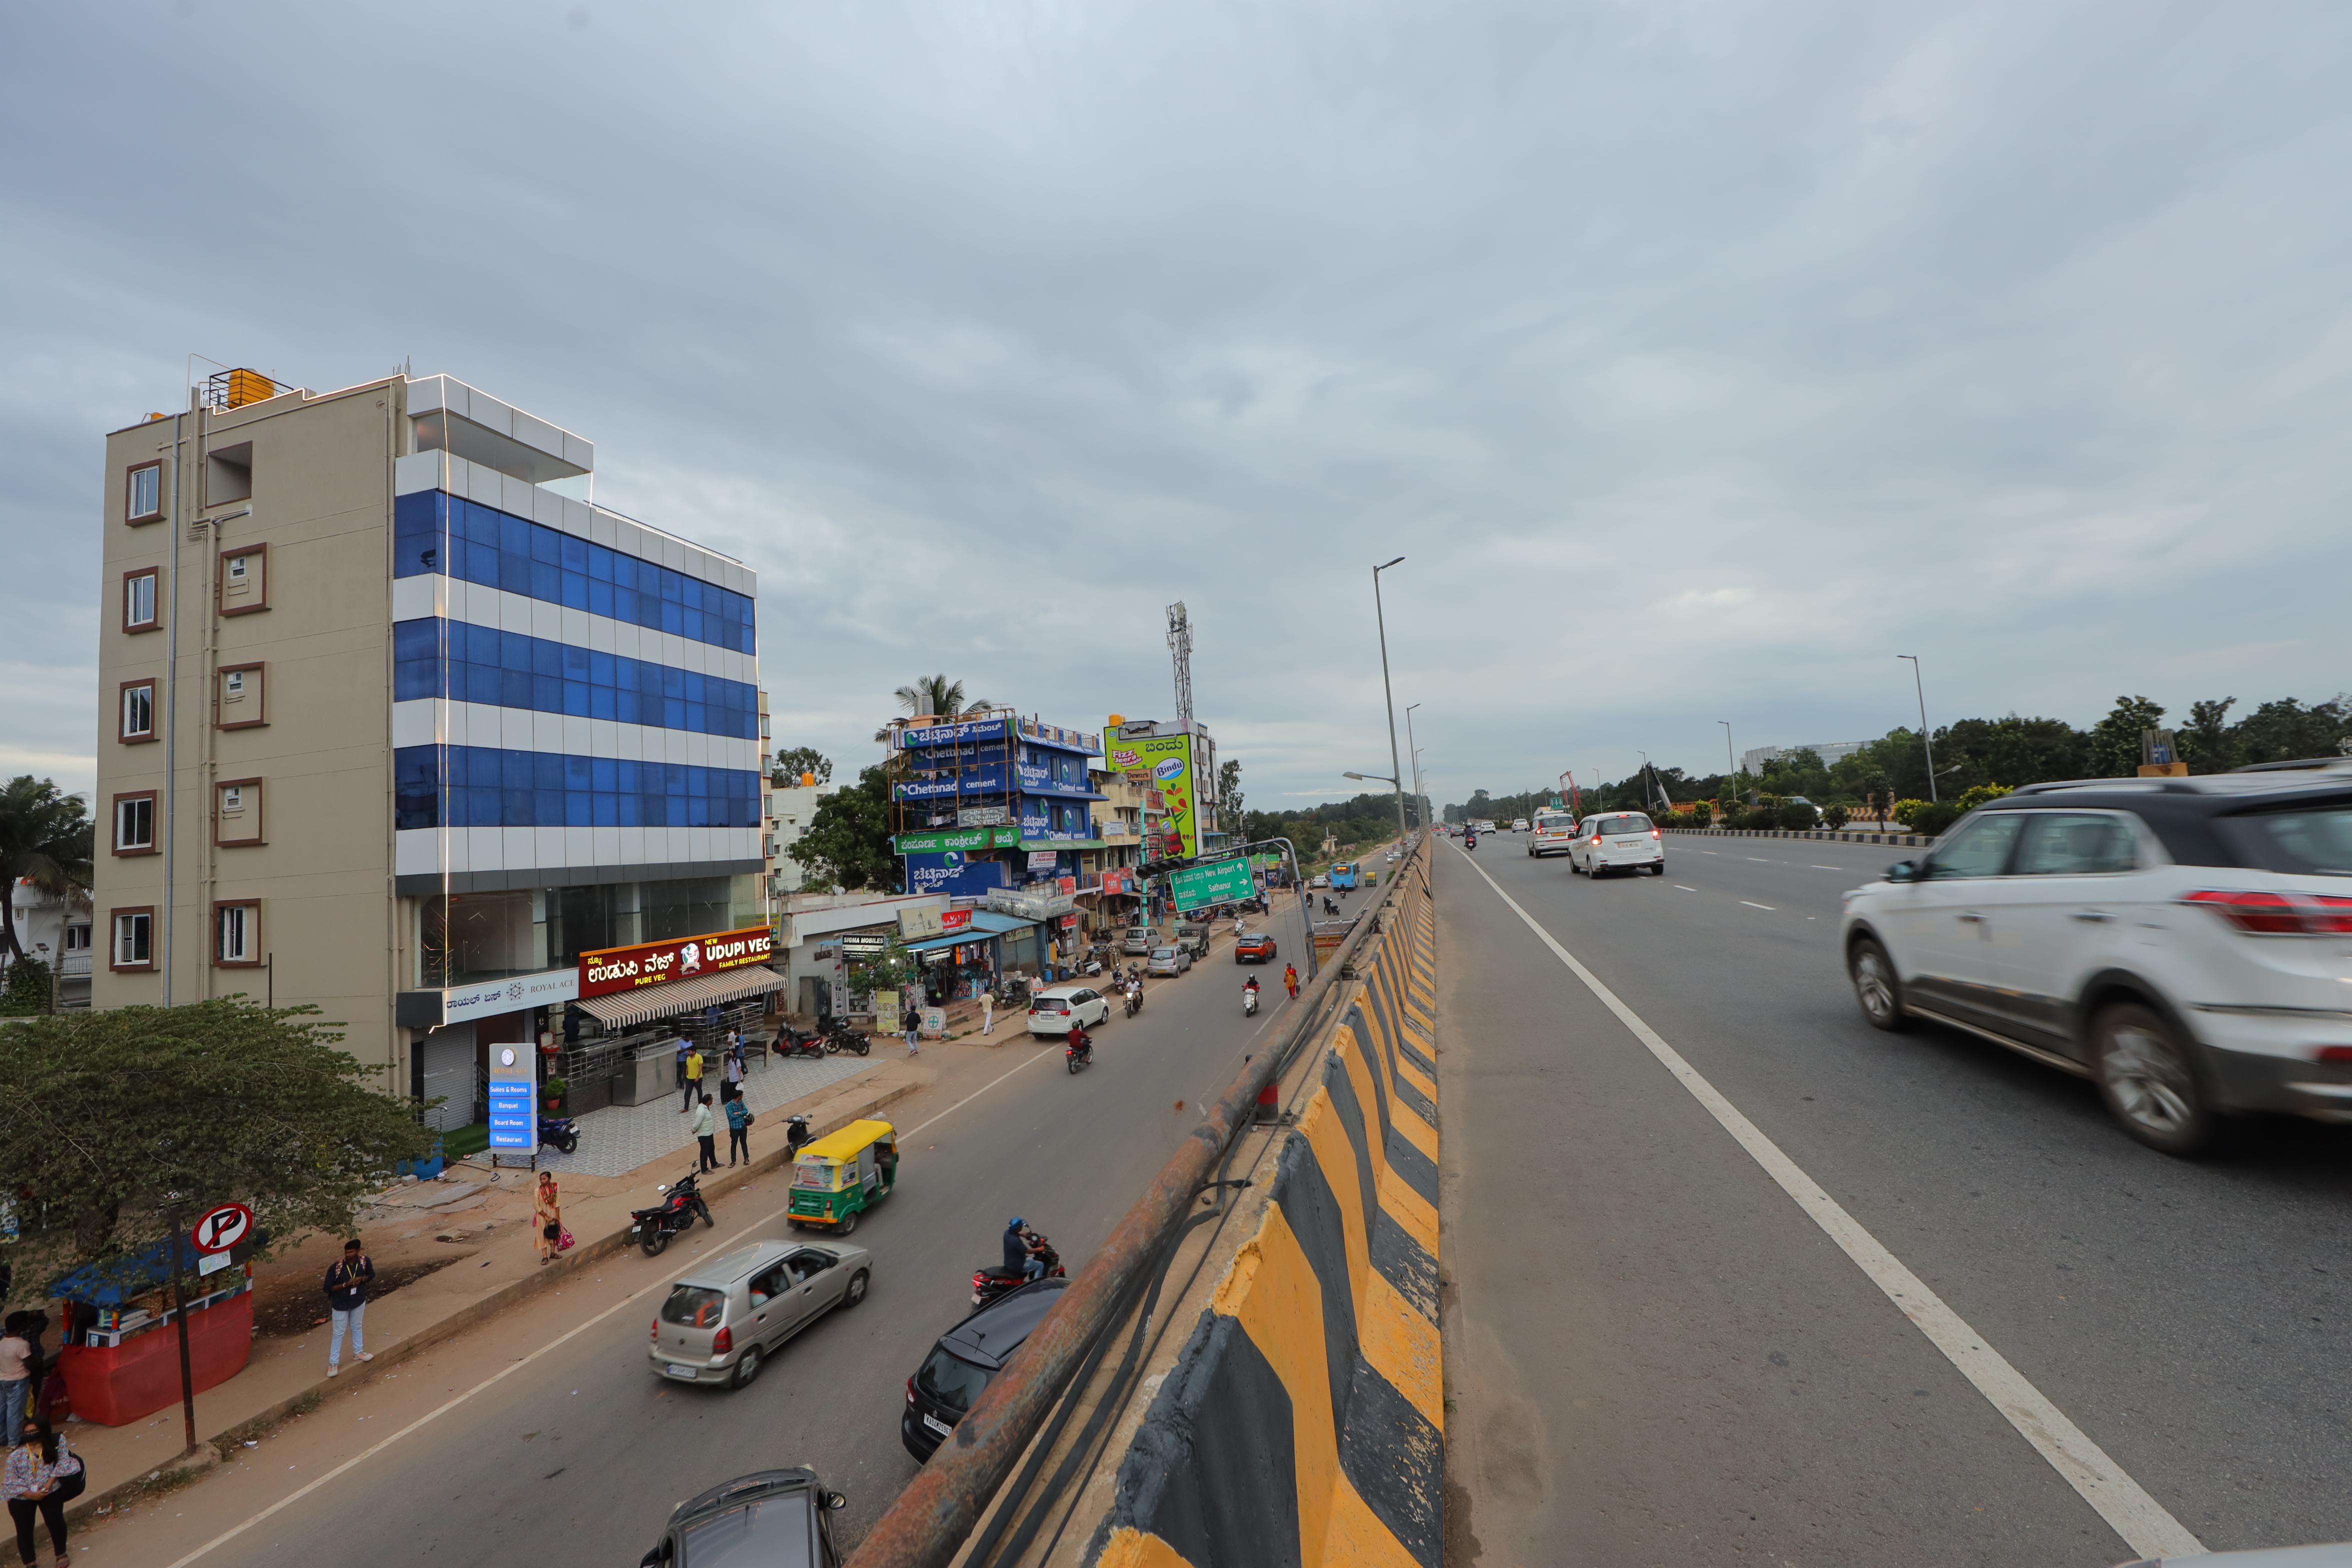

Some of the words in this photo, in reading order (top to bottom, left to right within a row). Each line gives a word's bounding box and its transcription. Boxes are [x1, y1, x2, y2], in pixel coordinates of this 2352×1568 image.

[1146, 739, 1183, 752] ಬಿಂದು
[1112, 749, 1134, 758] Fizz
[1114, 754, 1136, 763] Jeera
[1122, 758, 1142, 767] Masala
[1156, 762, 1182, 776] Bindu
[907, 780, 957, 795] Chettinad
[966, 778, 996, 788] cement
[1050, 831, 1072, 840] Chettinad
[1205, 870, 1216, 878] New
[1218, 864, 1236, 876] Airport
[1208, 882, 1231, 892] Sathanur
[1211, 893, 1229, 902] BAGALUR
[706, 941, 744, 961] UDUPI
[748, 937, 770, 953] VEG
[588, 956, 602, 965] ನ್ಯೂ
[588, 960, 638, 982] ಉಡುಪಿ
[644, 952, 674, 972] ವೆಜ್
[719, 960, 738, 968] FAMILY
[739, 953, 770, 964] RESTAURANT
[635, 976, 652, 986] PURE
[653, 974, 666, 982] VEG
[530, 983, 557, 994] ROYAL
[558, 980, 575, 988] ACE
[447, 994, 480, 1008] ರಾಯಲ್
[484, 990, 501, 1002] ಏಸ್
[211, 1209, 242, 1247] P
